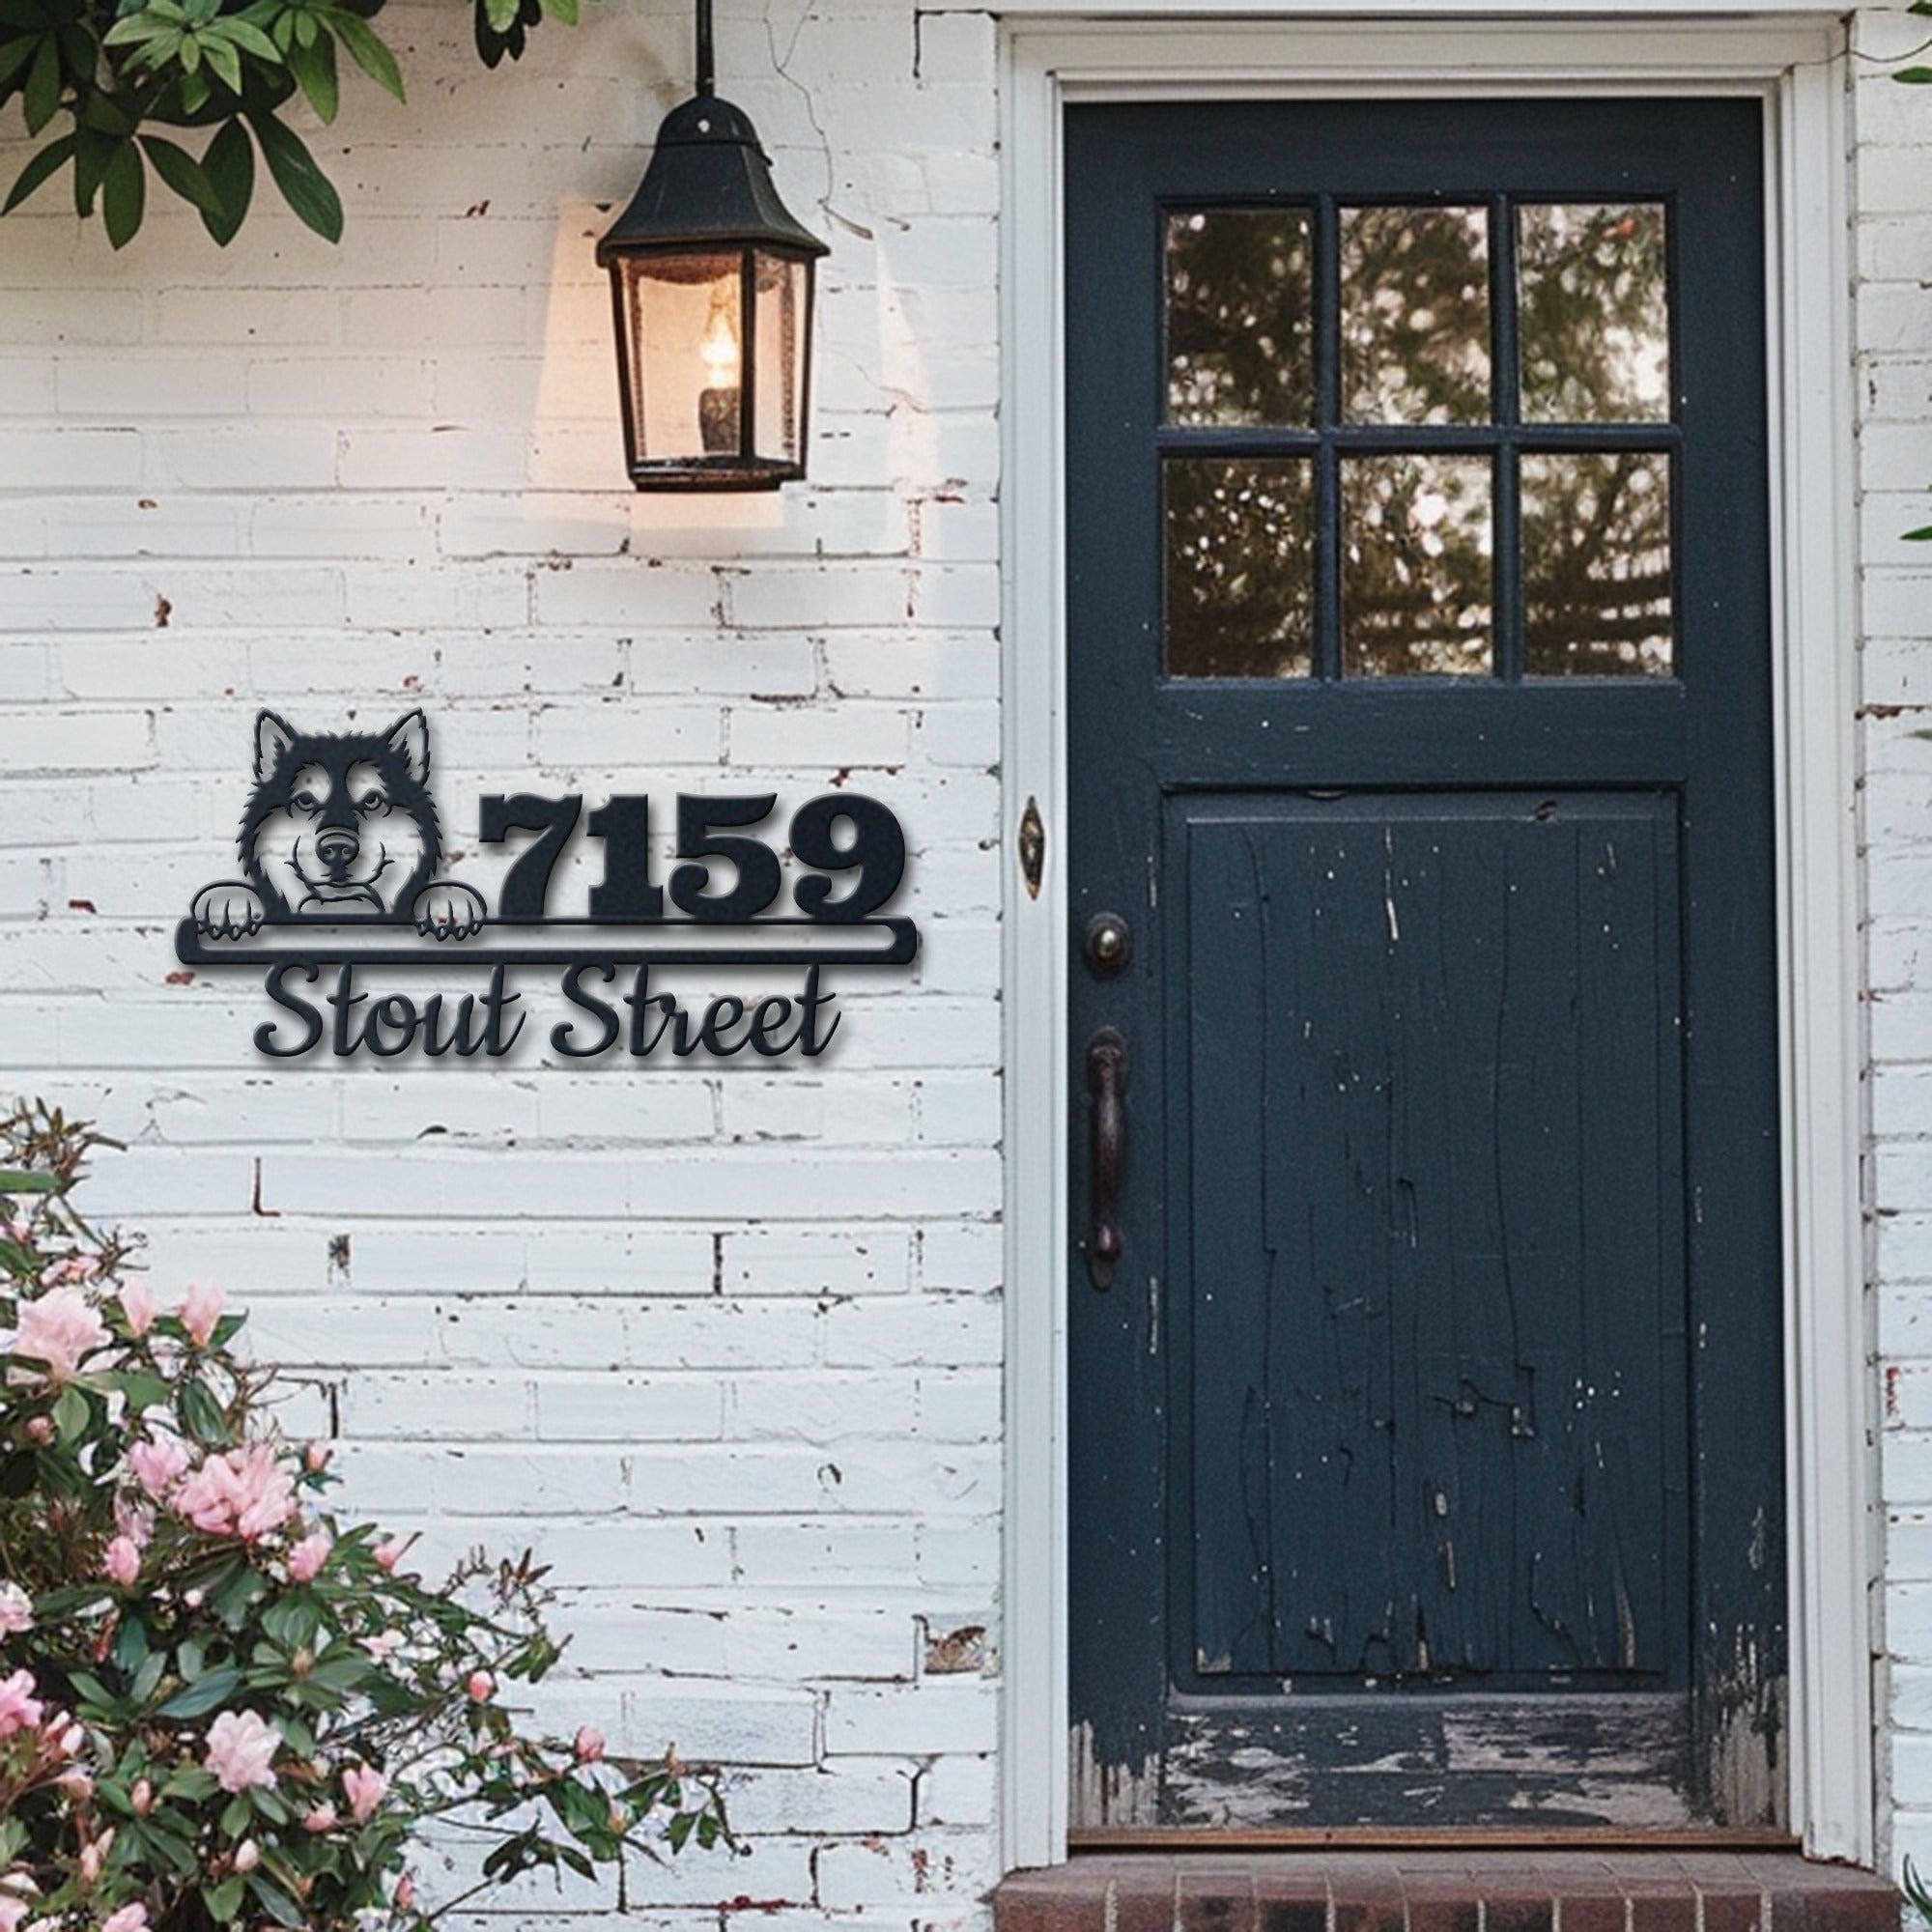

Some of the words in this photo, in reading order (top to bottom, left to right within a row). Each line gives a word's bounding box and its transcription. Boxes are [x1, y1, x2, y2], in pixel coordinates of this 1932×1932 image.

[478, 793, 906, 918] 7159
[253, 964, 527, 1057] Stout
[550, 964, 841, 1057] Street
